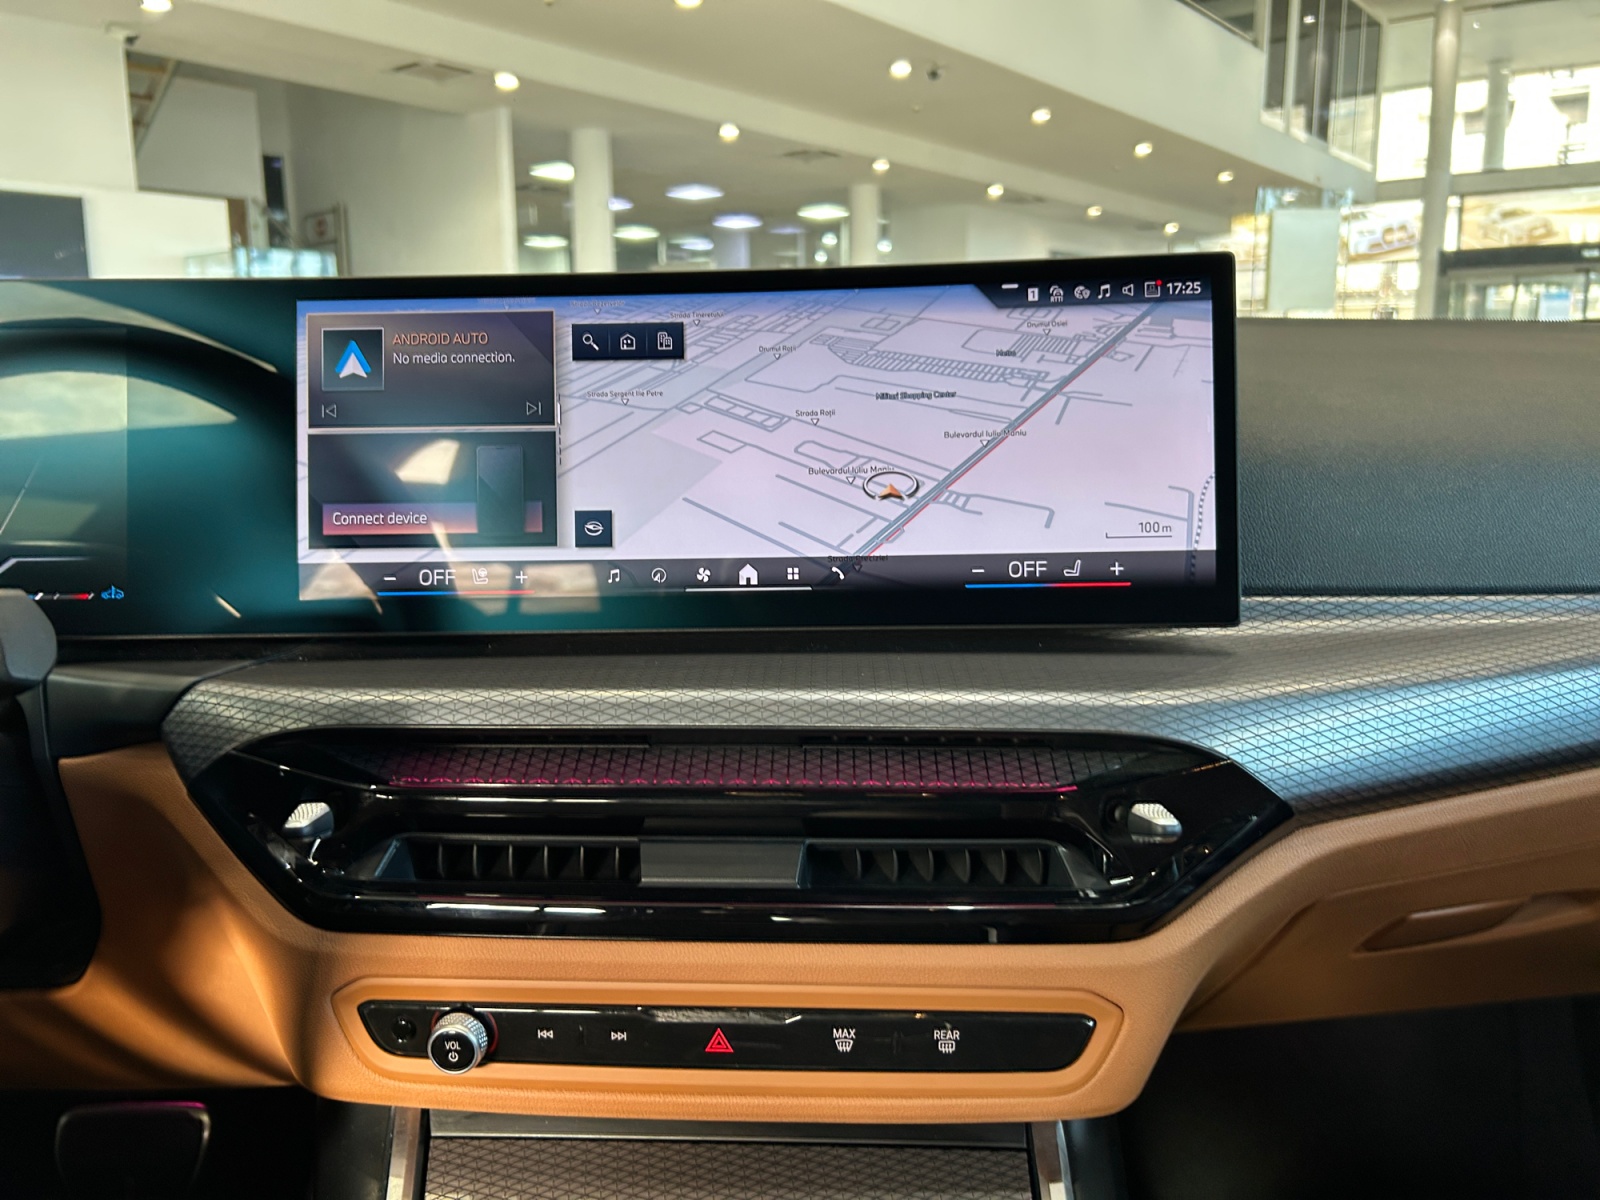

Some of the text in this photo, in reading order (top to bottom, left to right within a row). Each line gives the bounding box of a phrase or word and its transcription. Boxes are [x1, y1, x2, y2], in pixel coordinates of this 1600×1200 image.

[1166, 282, 1201, 294] 17:25
[1027, 321, 1050, 329] Drumul
[392, 332, 488, 345] ANDROID AUTO
[758, 345, 781, 353] Drumul
[393, 351, 515, 364] No media connection.
[586, 390, 608, 398] Strada
[609, 390, 635, 399] Sergent
[646, 389, 664, 397] Petre
[795, 409, 819, 417] Strada
[943, 430, 984, 439] Bulevardul
[1003, 429, 1027, 437] Maniu
[808, 466, 849, 475] Bulevardul
[332, 511, 427, 525] Connect device
[1138, 522, 1172, 533] 100 m
[828, 555, 853, 563] Strada
[1008, 560, 1048, 578] OFF
[419, 569, 457, 586] OFF
[832, 1028, 856, 1039] MAX
[933, 1030, 960, 1040] REAR
[444, 1041, 461, 1050] VOL
